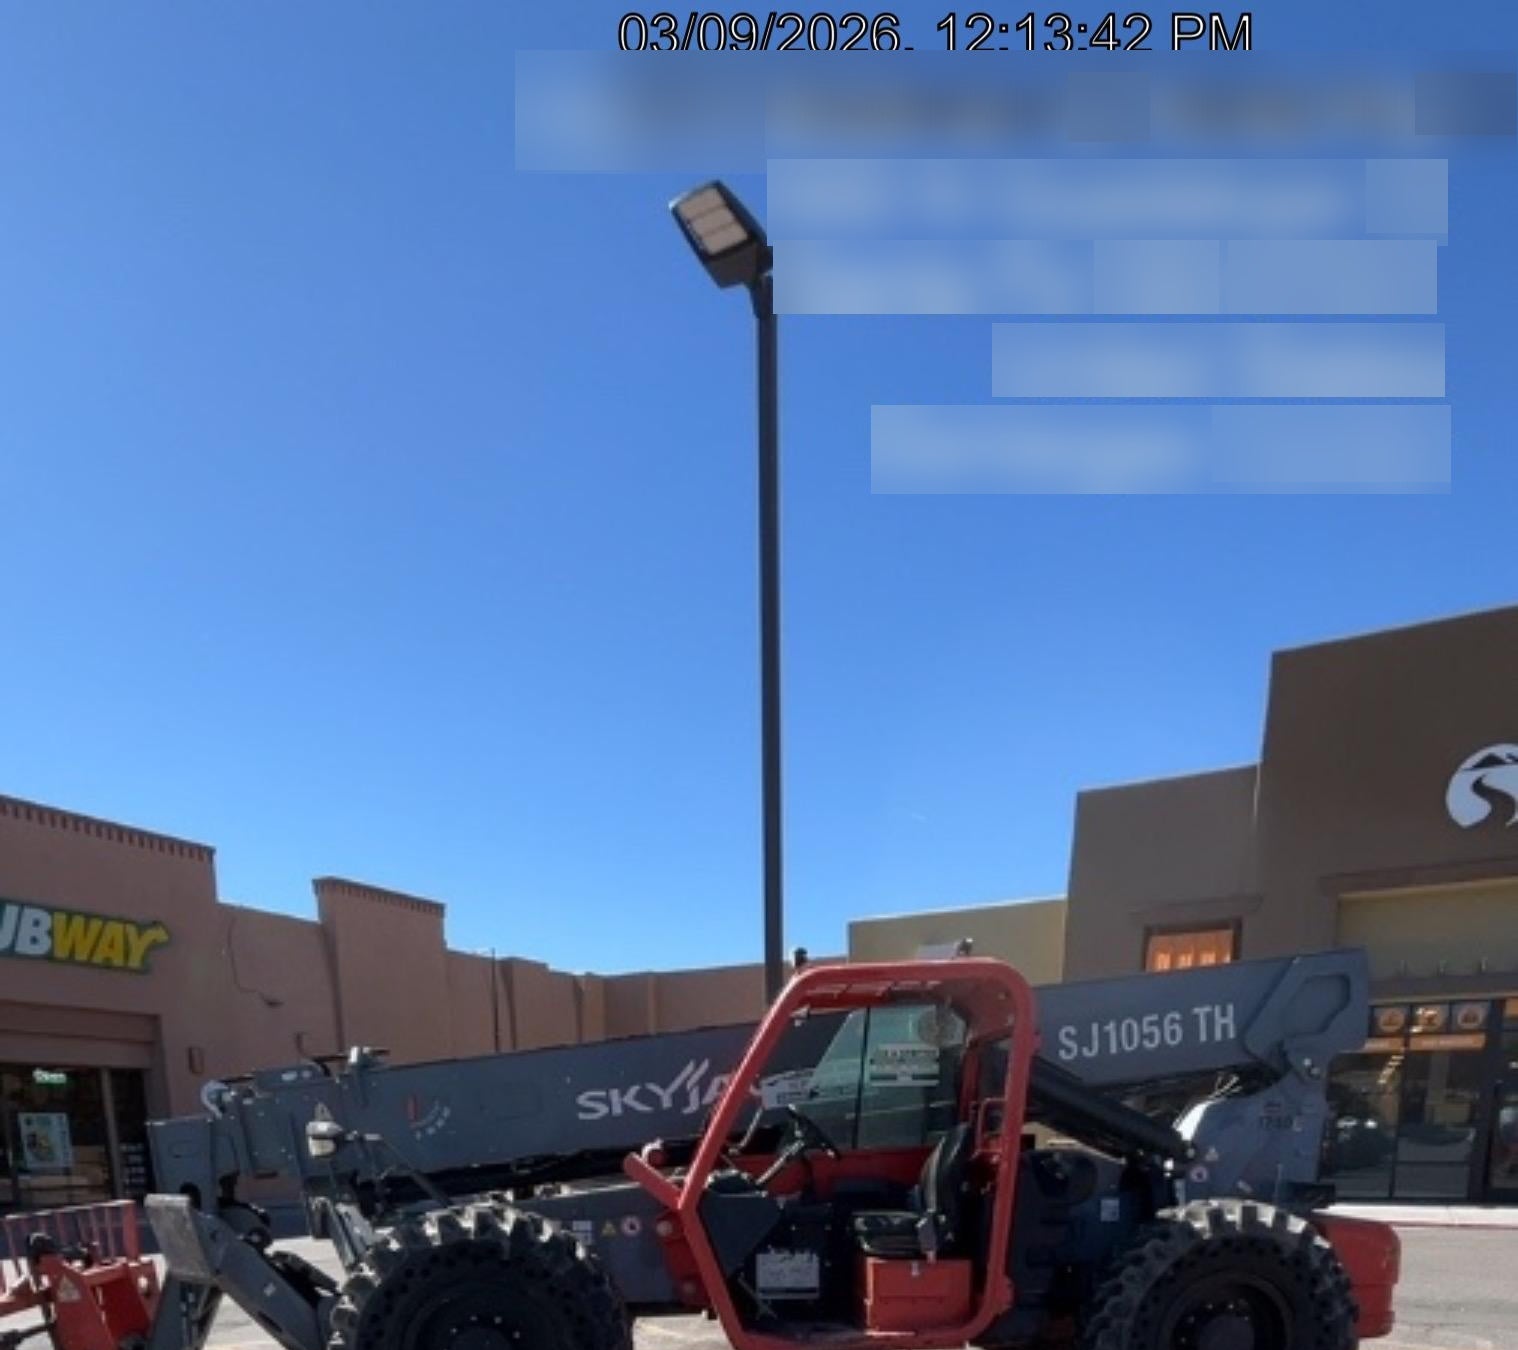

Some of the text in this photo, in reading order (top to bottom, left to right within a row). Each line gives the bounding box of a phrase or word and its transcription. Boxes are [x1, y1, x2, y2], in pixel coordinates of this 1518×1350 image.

[1058, 1003, 1236, 1060] SJ1056 TH
[576, 1058, 762, 1120] SKYJA
